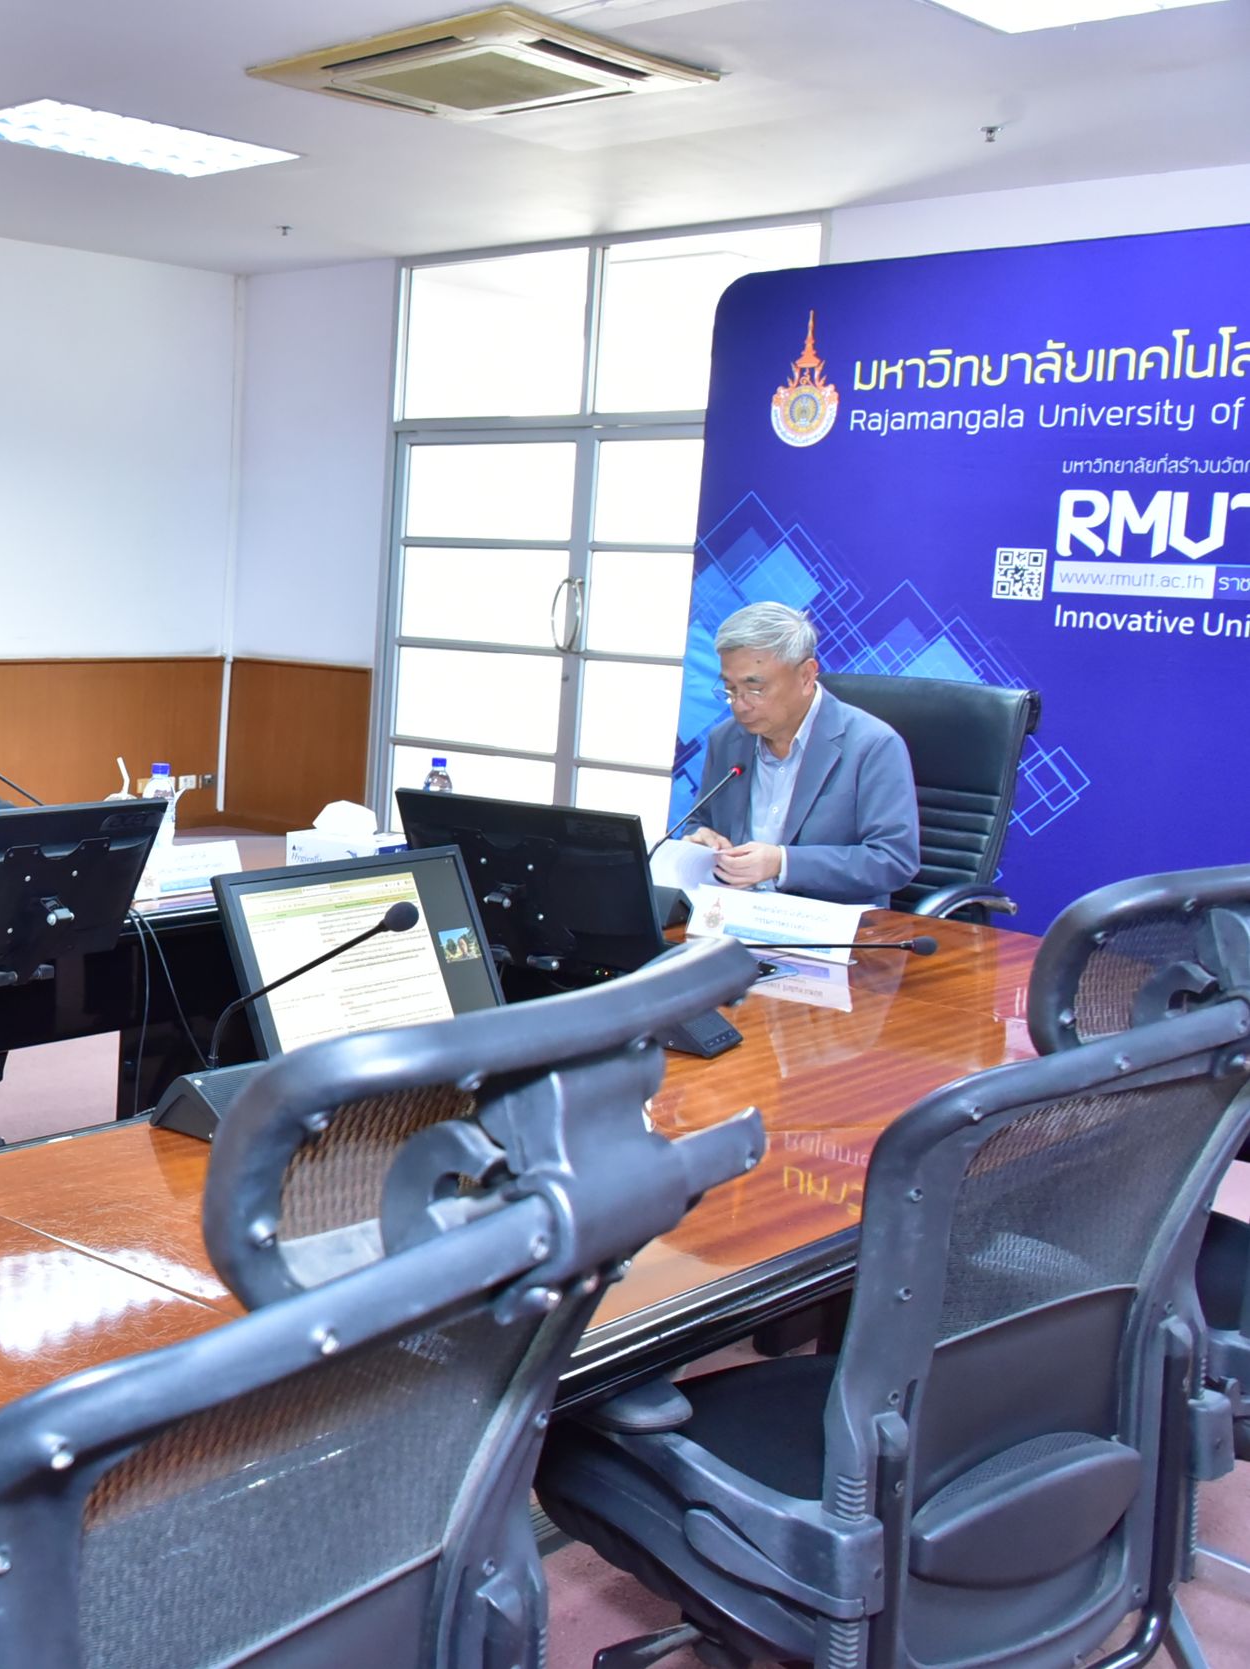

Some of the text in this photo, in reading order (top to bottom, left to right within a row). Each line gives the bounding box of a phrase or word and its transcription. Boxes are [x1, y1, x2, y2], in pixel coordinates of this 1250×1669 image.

[853, 326, 1250, 391] มหาวิทยาลัยเทคโนโล
[850, 403, 1025, 436] Rajamangala
[1038, 397, 1195, 431] University
[1210, 396, 1246, 430] of
[1059, 570, 1204, 590] www.rmutt.ac.th
[1054, 604, 1250, 639] Innovative Uni
